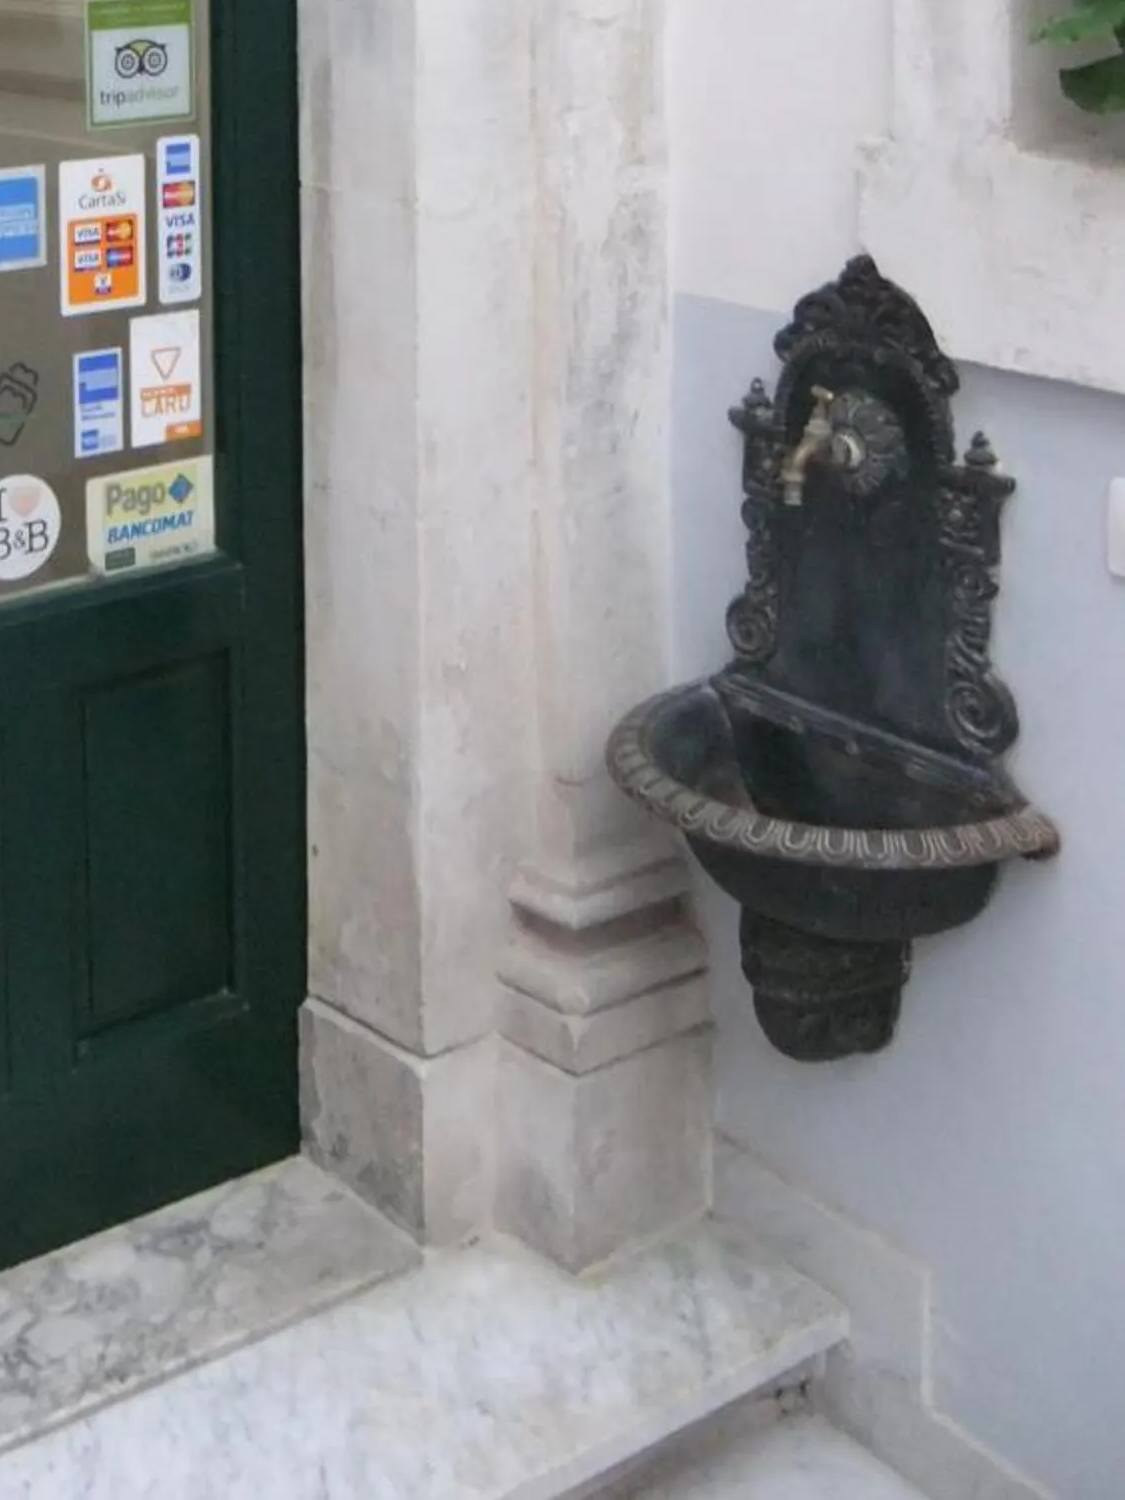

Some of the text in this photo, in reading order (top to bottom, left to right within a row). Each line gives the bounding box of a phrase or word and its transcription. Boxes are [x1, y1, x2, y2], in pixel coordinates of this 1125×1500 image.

[166, 213, 195, 228] VISA
[106, 481, 167, 516] Pago
[107, 509, 195, 544] BANCOMAT
